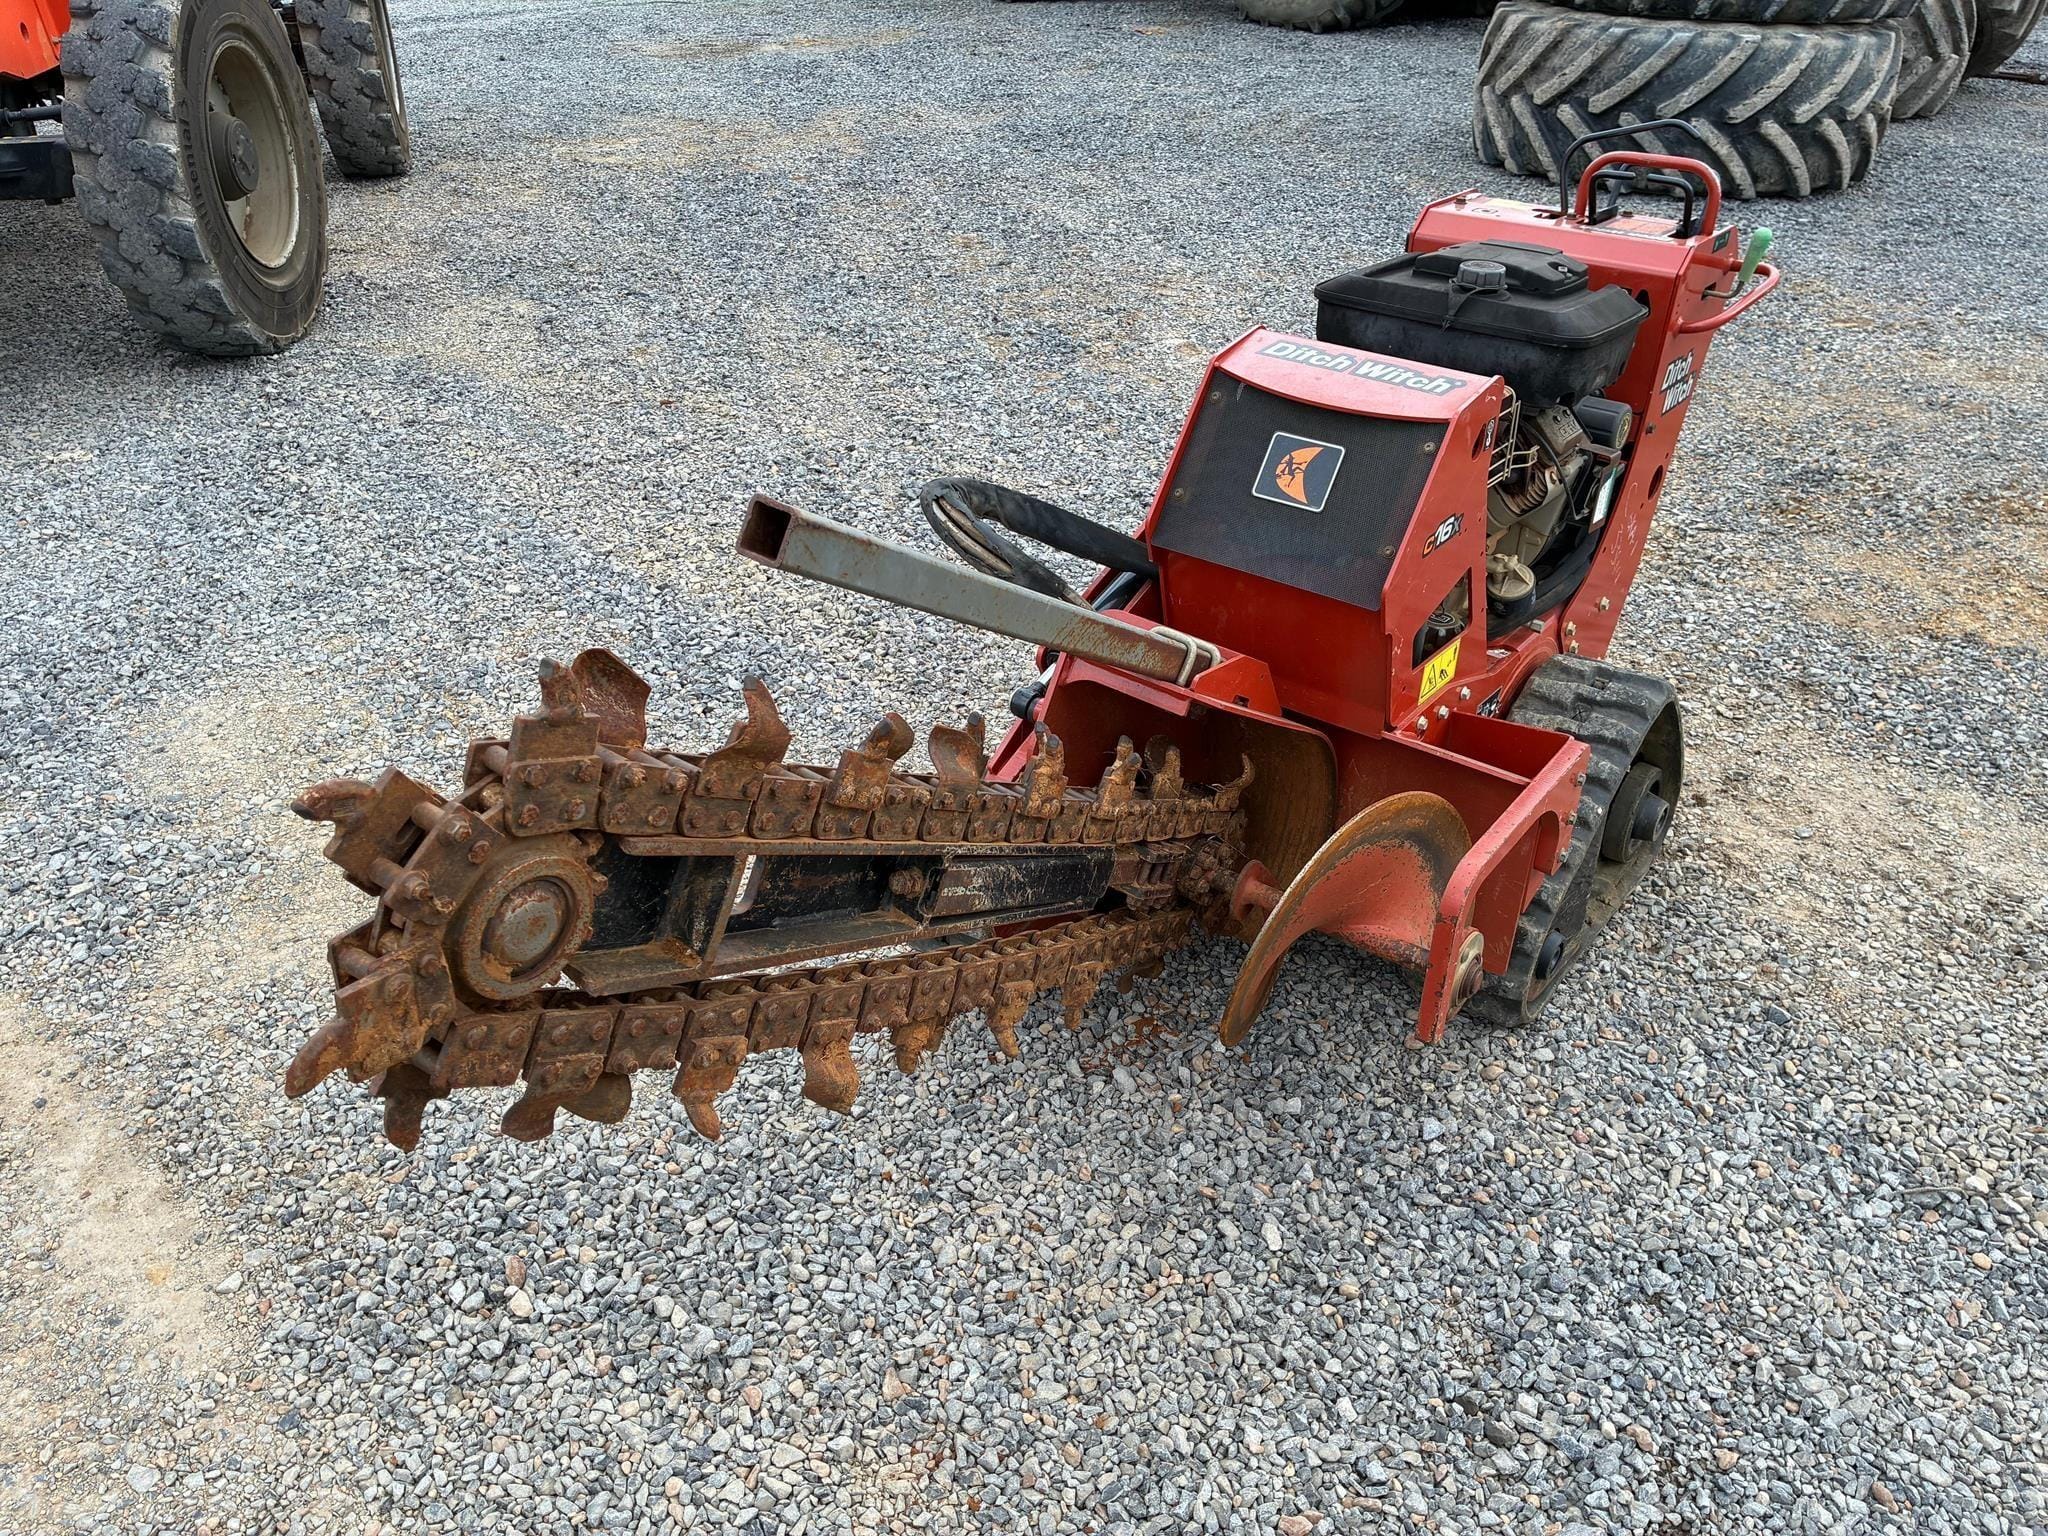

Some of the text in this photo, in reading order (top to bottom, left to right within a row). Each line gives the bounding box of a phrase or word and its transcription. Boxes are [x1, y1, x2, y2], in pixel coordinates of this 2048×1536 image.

[1263, 342, 1451, 394] Ditch Witch
[1661, 352, 1693, 390] Ditch
[1662, 374, 1694, 414] Witch
